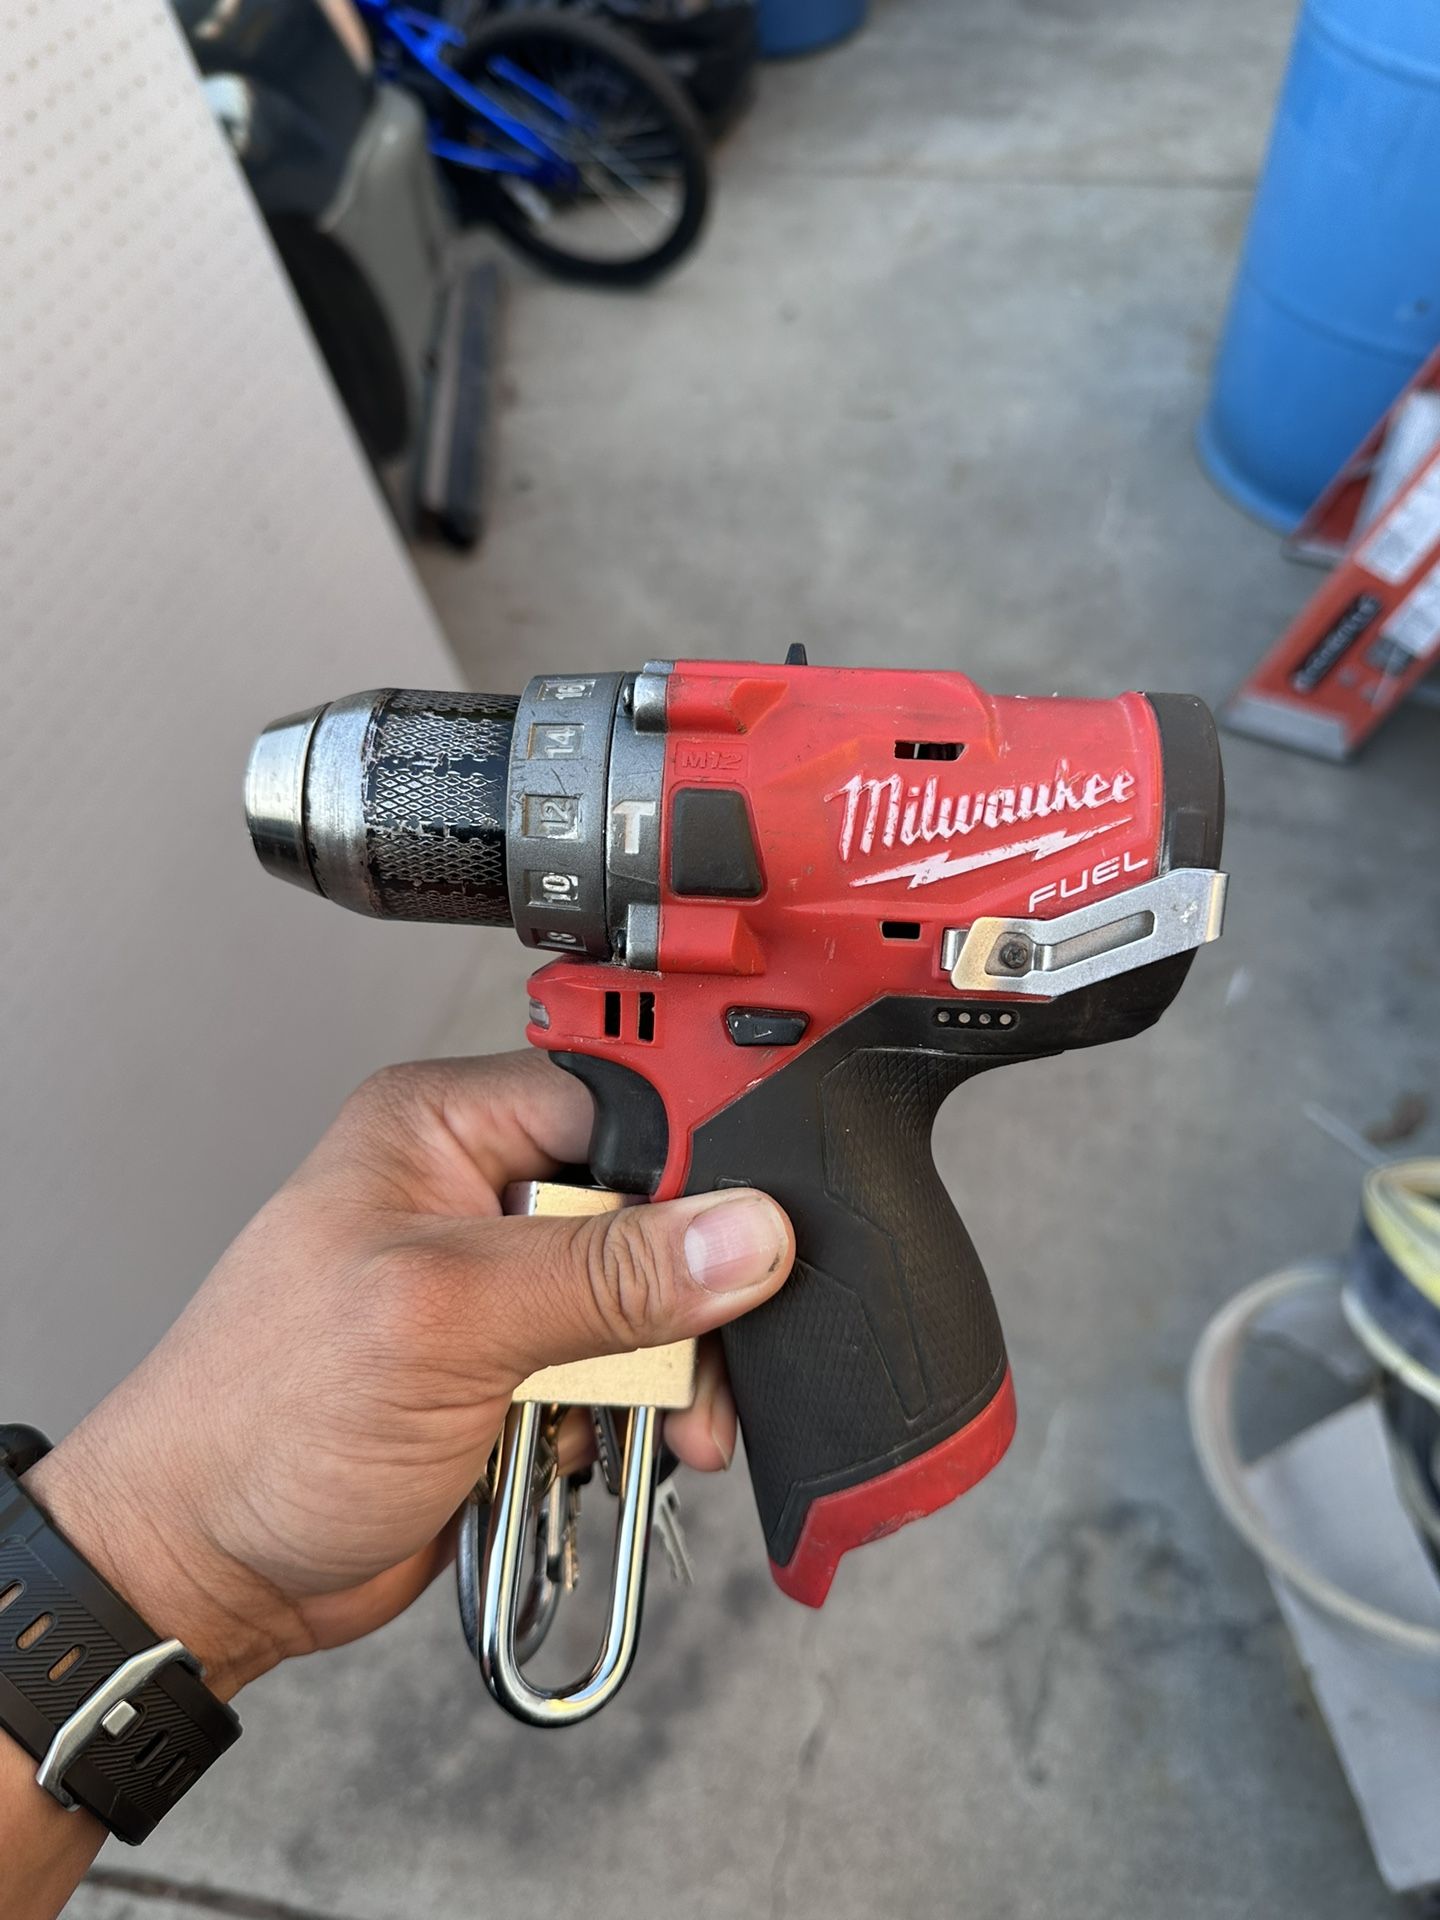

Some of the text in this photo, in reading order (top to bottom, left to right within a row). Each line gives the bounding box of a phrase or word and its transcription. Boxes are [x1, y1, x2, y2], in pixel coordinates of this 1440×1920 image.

[545, 727, 576, 757] 14
[682, 751, 743, 769] M12
[540, 798, 569, 828] 12
[823, 760, 1135, 861] Milwaukee
[542, 872, 575, 902] 10
[1028, 852, 1148, 913] FUEL
[547, 931, 576, 944] 8
